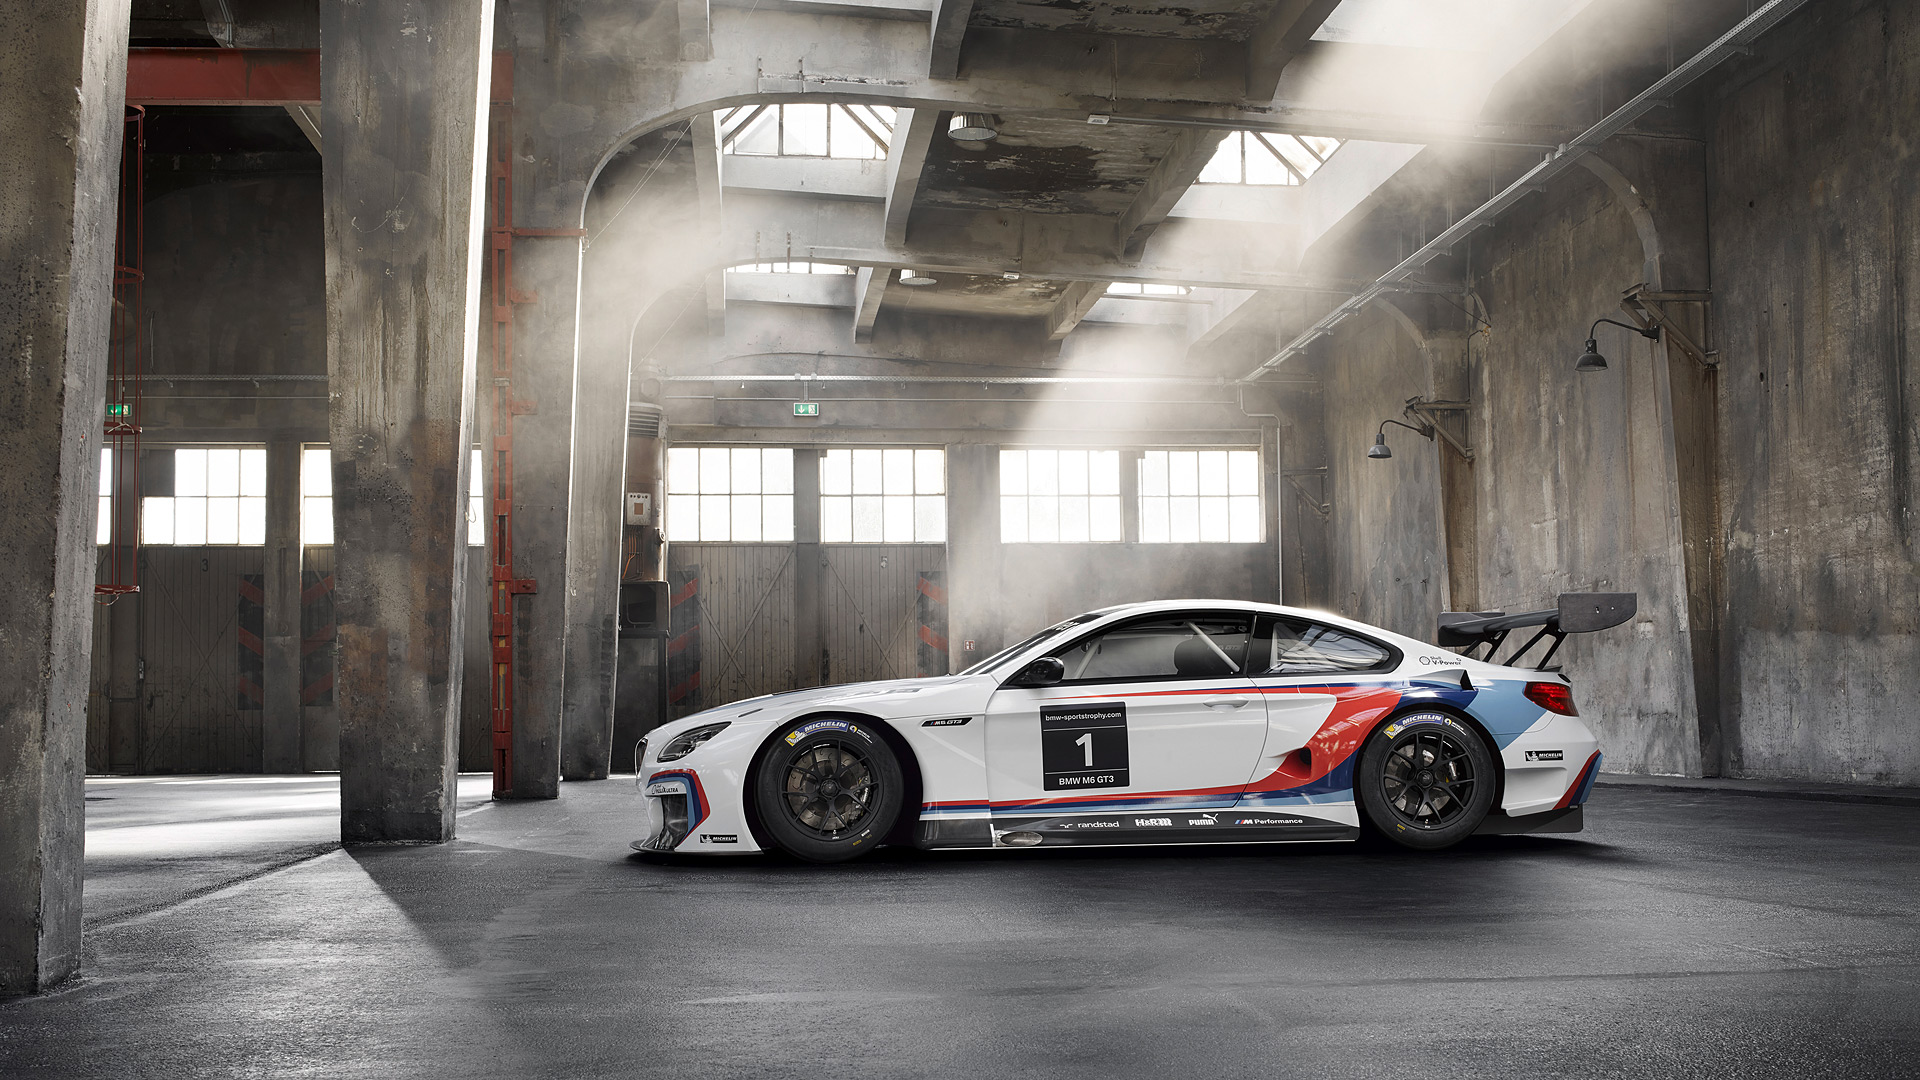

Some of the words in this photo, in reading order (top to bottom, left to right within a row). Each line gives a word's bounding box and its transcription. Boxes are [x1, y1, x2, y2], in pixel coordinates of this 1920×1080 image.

[201, 558, 209, 572] 3
[1045, 712, 1122, 721] bmw-sportstrophy.com
[1402, 714, 1442, 725] MICHELIN
[804, 721, 847, 732] MICHELIN
[1075, 733, 1093, 767] 1
[1058, 777, 1081, 786] BMW
[1082, 776, 1096, 784] M6
[1096, 775, 1115, 784] GT3
